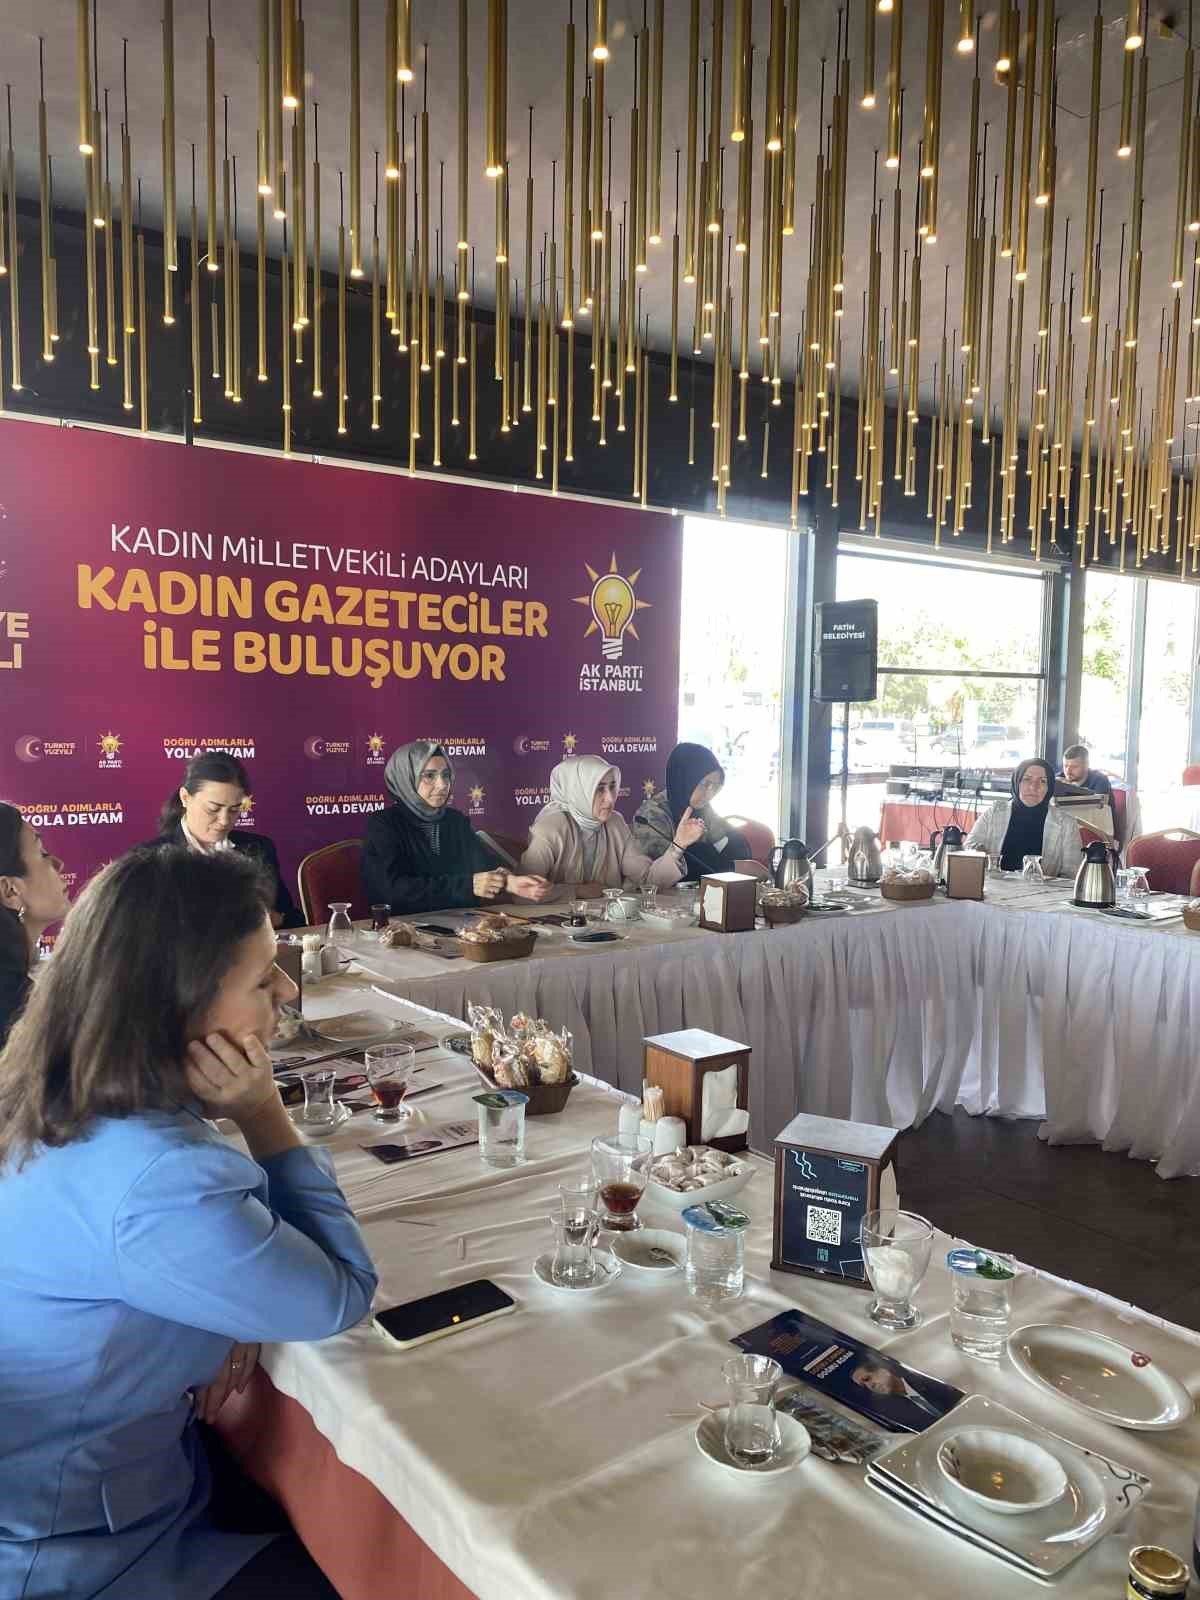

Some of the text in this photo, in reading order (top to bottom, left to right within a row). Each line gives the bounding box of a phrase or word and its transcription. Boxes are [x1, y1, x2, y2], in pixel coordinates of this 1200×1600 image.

[111, 523, 213, 560] KADIN
[411, 556, 529, 590] ADAYLARI
[77, 564, 253, 620] KADIN
[233, 631, 507, 689] BULUŞUYOR
[580, 663, 601, 678] AK
[163, 737, 255, 746] DOĞRU ADIMLARLA
[164, 747, 202, 759] YOLA
[448, 745, 486, 756] DEVAM
[602, 743, 657, 753] YOLA DEVAM
[515, 795, 541, 806] YOLA
[20, 802, 122, 814] DOĞRU ADIMLARLA
[306, 802, 385, 815] YOLA DEVAM
[20, 812, 123, 827] YOLA DEVAM
